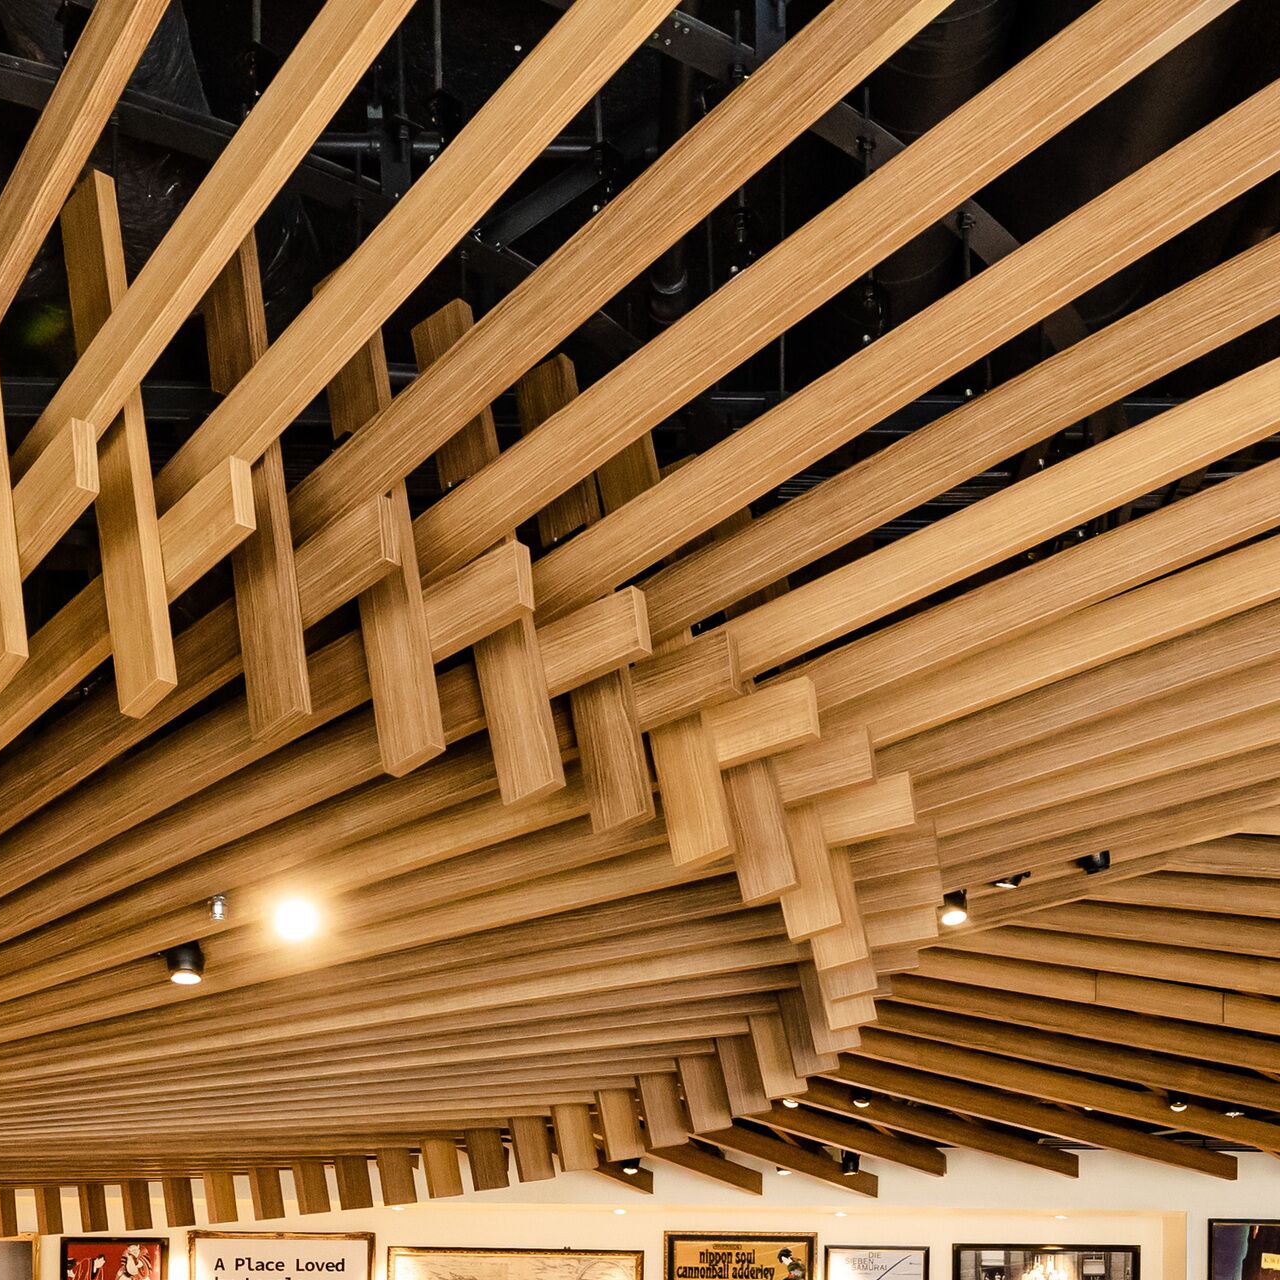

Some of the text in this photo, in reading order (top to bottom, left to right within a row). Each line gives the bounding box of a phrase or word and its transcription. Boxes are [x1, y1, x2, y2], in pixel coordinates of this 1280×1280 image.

[214, 1257, 346, 1272] A Place Loved
[699, 1249, 755, 1266] nippon soul
[677, 1263, 729, 1279] cannonball
